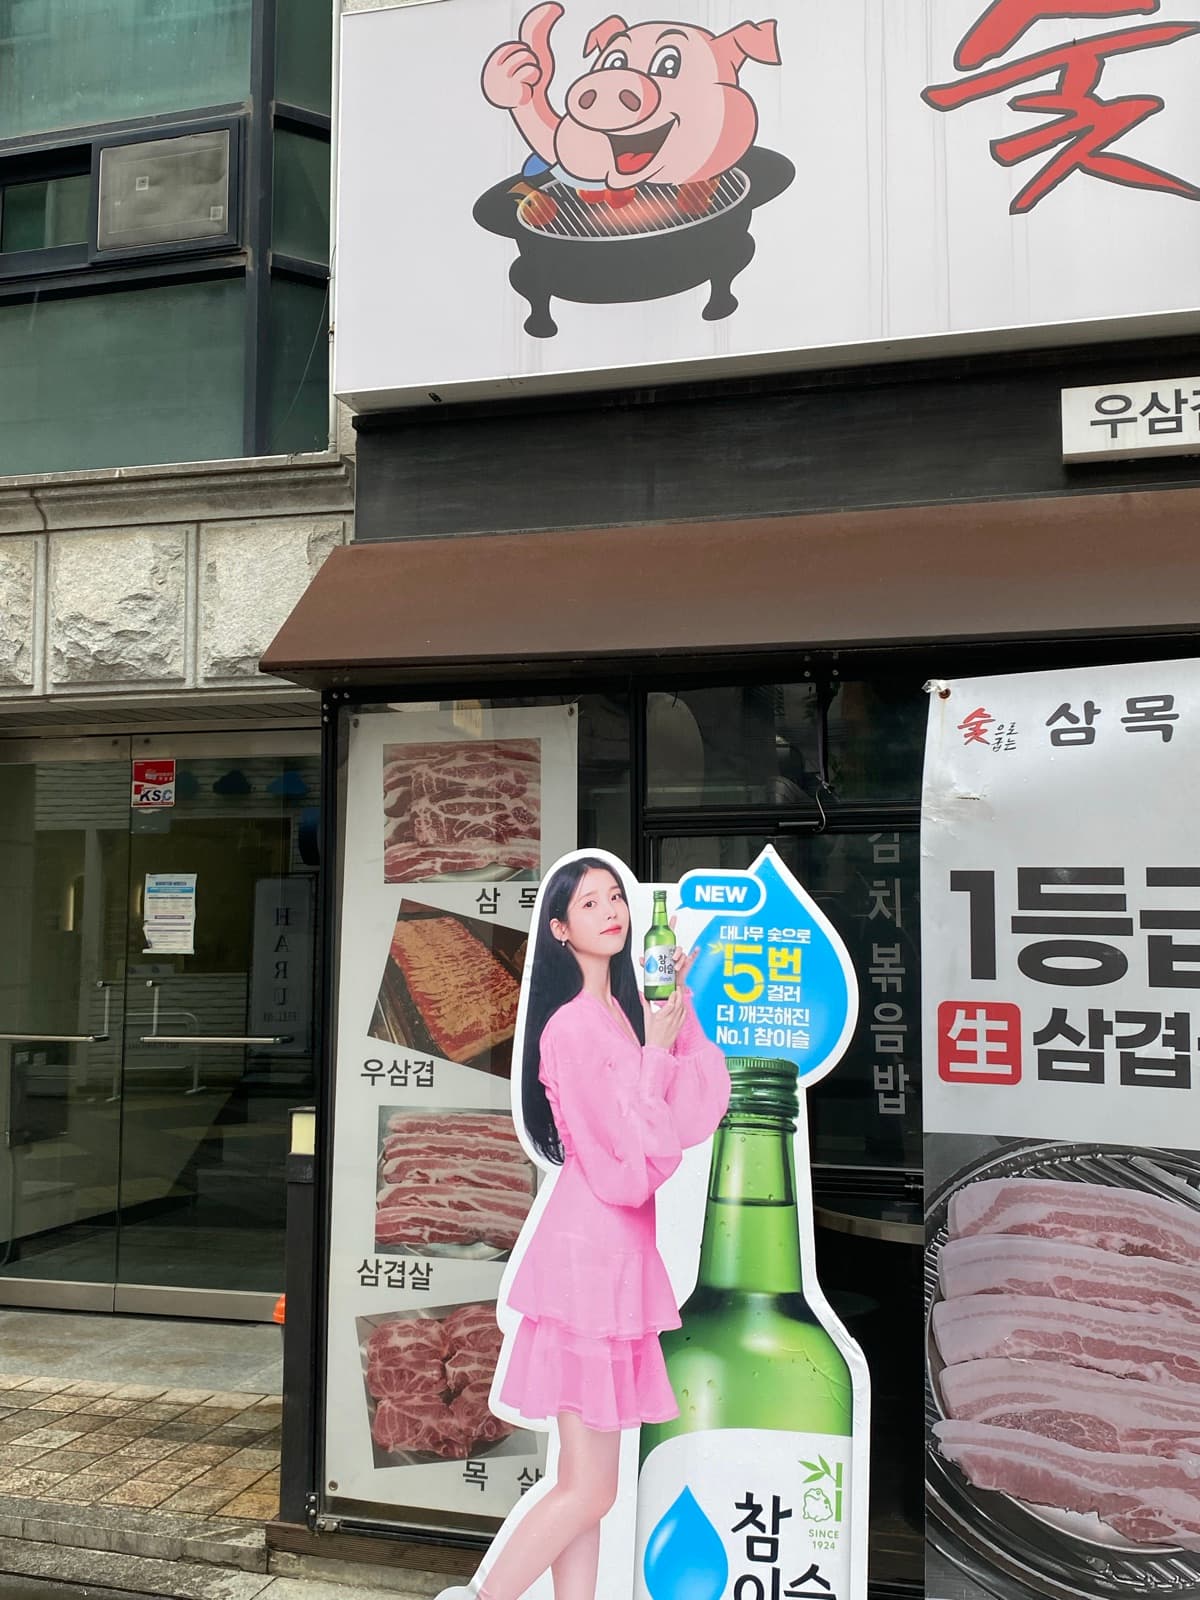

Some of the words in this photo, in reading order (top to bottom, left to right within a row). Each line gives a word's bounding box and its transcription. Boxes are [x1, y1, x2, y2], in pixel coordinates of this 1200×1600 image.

[1090, 388, 1200, 439] 우삼
[140, 789, 172, 801] KSC
[694, 884, 748, 904] NEW
[720, 925, 764, 942] 대나무
[767, 927, 811, 945] 숯으로
[722, 944, 803, 1003] 5번
[767, 984, 801, 1003] 걸러
[716, 1004, 735, 1024] 더
[738, 1005, 810, 1027] 깨끗해진
[716, 1024, 750, 1046] No.1
[754, 1026, 810, 1049] 참이슬
[946, 1008, 1013, 1075] 生
[1033, 1008, 1200, 1089] 삼겹
[360, 1058, 435, 1088] 우삼겹
[357, 1258, 434, 1291] 삼겹살
[808, 1529, 840, 1539] SINCE
[812, 1541, 836, 1550] 1924
